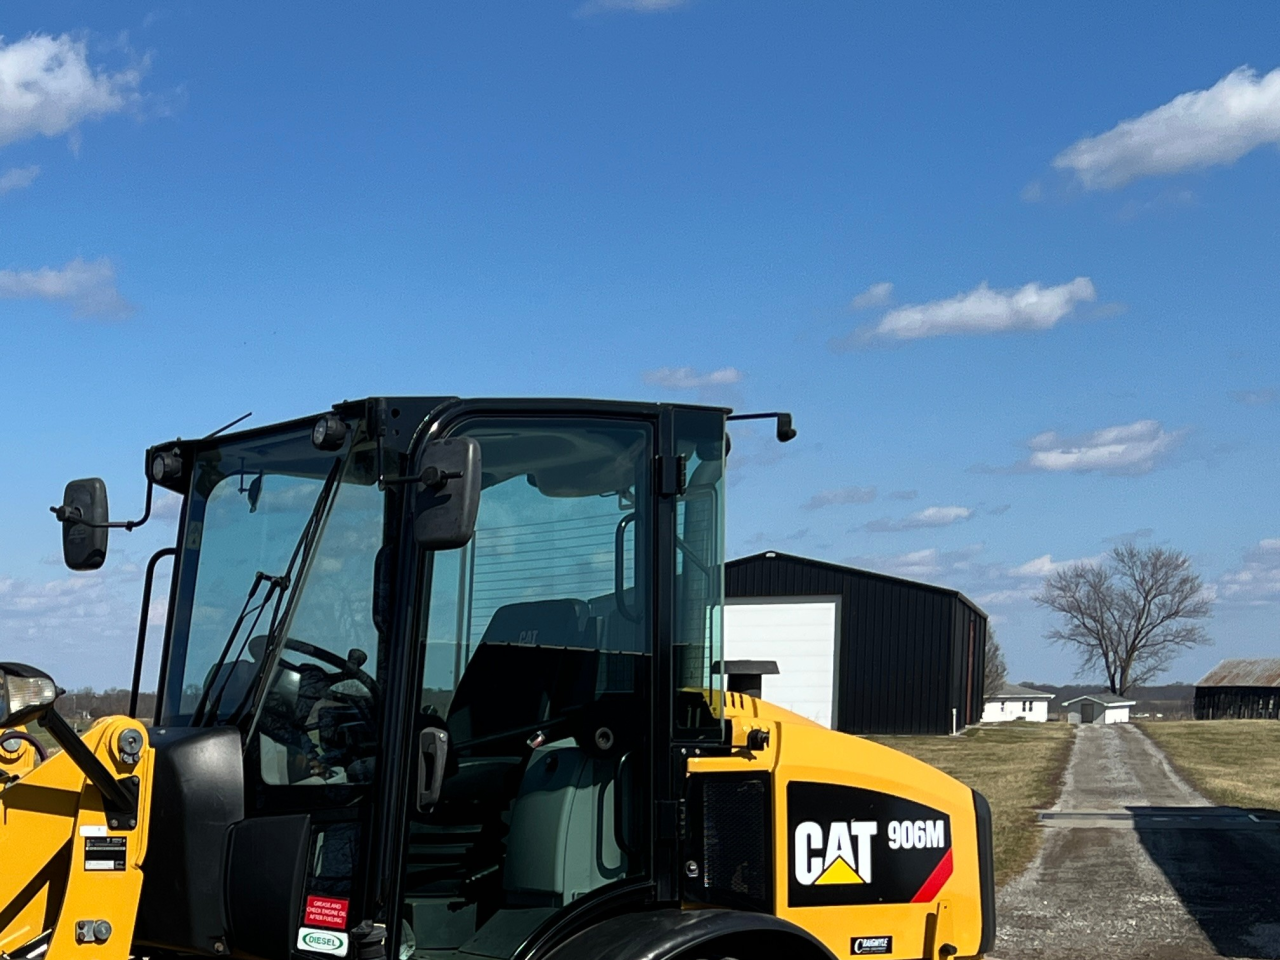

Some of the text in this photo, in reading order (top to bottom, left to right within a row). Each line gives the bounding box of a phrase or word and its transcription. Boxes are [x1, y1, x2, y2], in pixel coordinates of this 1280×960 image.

[795, 820, 945, 885] CAT 906M
[322, 908, 338, 916] ENGINE
[308, 936, 336, 946] DIESEL
